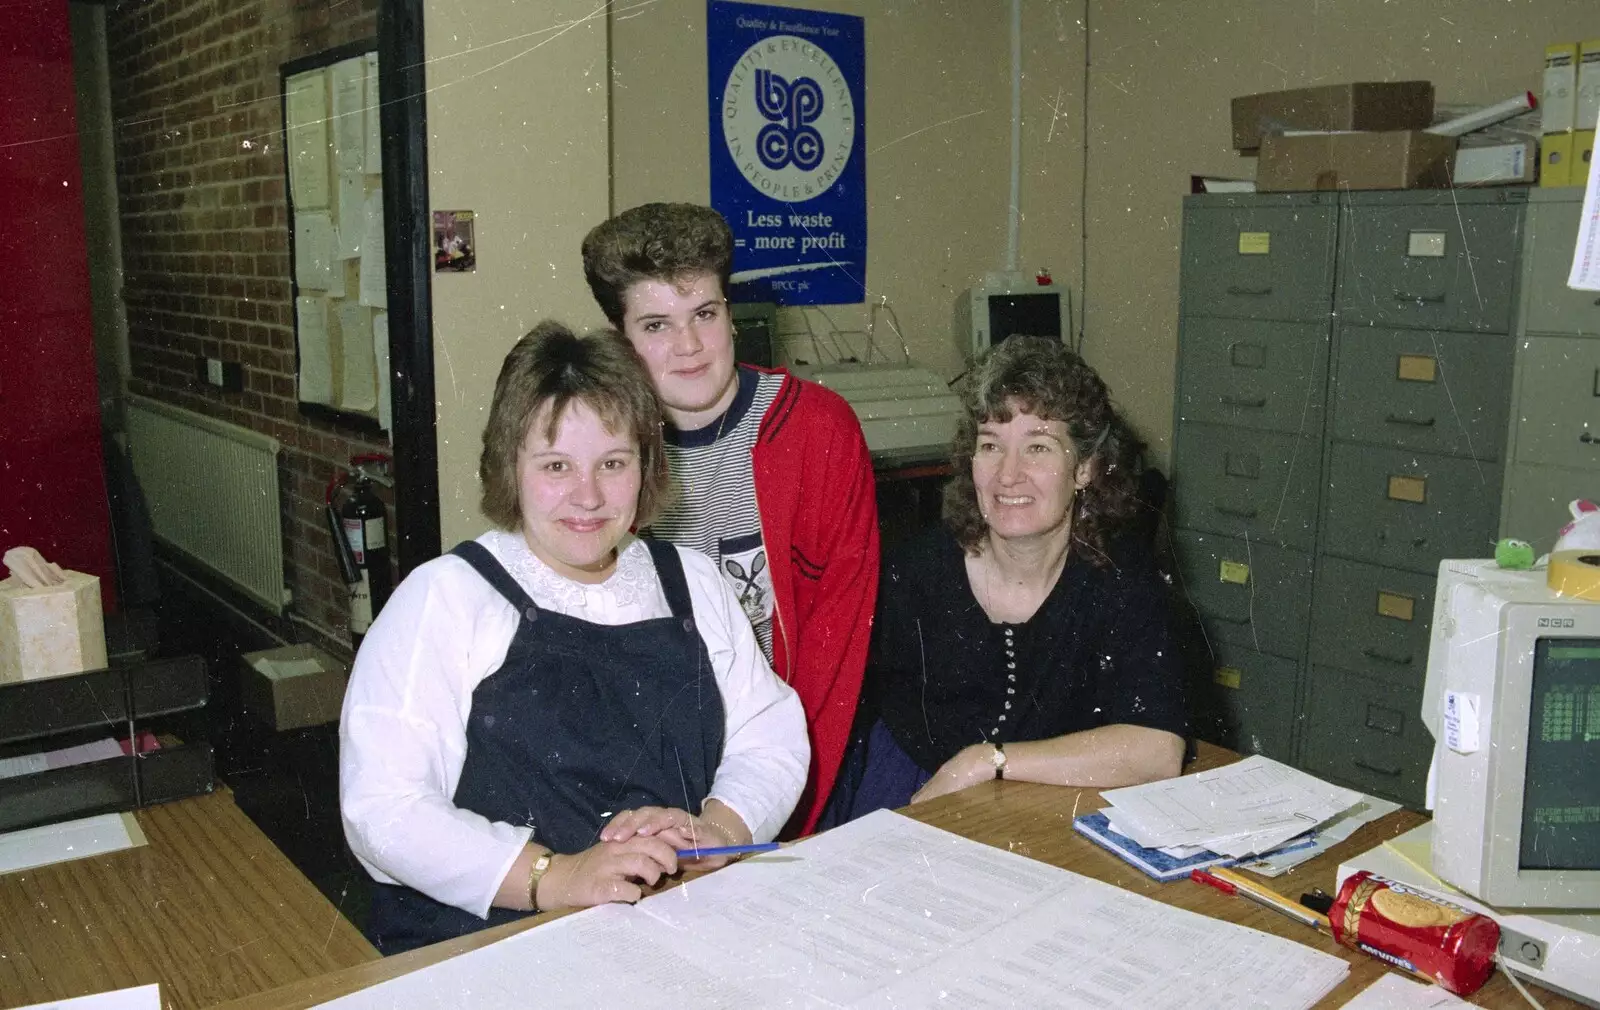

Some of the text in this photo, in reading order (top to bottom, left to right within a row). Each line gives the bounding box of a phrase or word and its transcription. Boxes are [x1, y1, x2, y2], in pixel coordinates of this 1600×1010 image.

[735, 16, 767, 29] Quality
[769, 19, 777, 30] &
[822, 26, 840, 36] Year
[726, 49, 763, 119] QUALITY
[781, 39, 851, 124] EXCELLENCE
[730, 137, 744, 158] IN
[743, 162, 800, 198] PEOPLE
[816, 140, 849, 188] PRINT
[747, 210, 833, 228] Less waste
[755, 236, 795, 249] more
[801, 231, 846, 254] profit
[771, 281, 797, 291] BPCC
[1537, 618, 1575, 629] NCR
